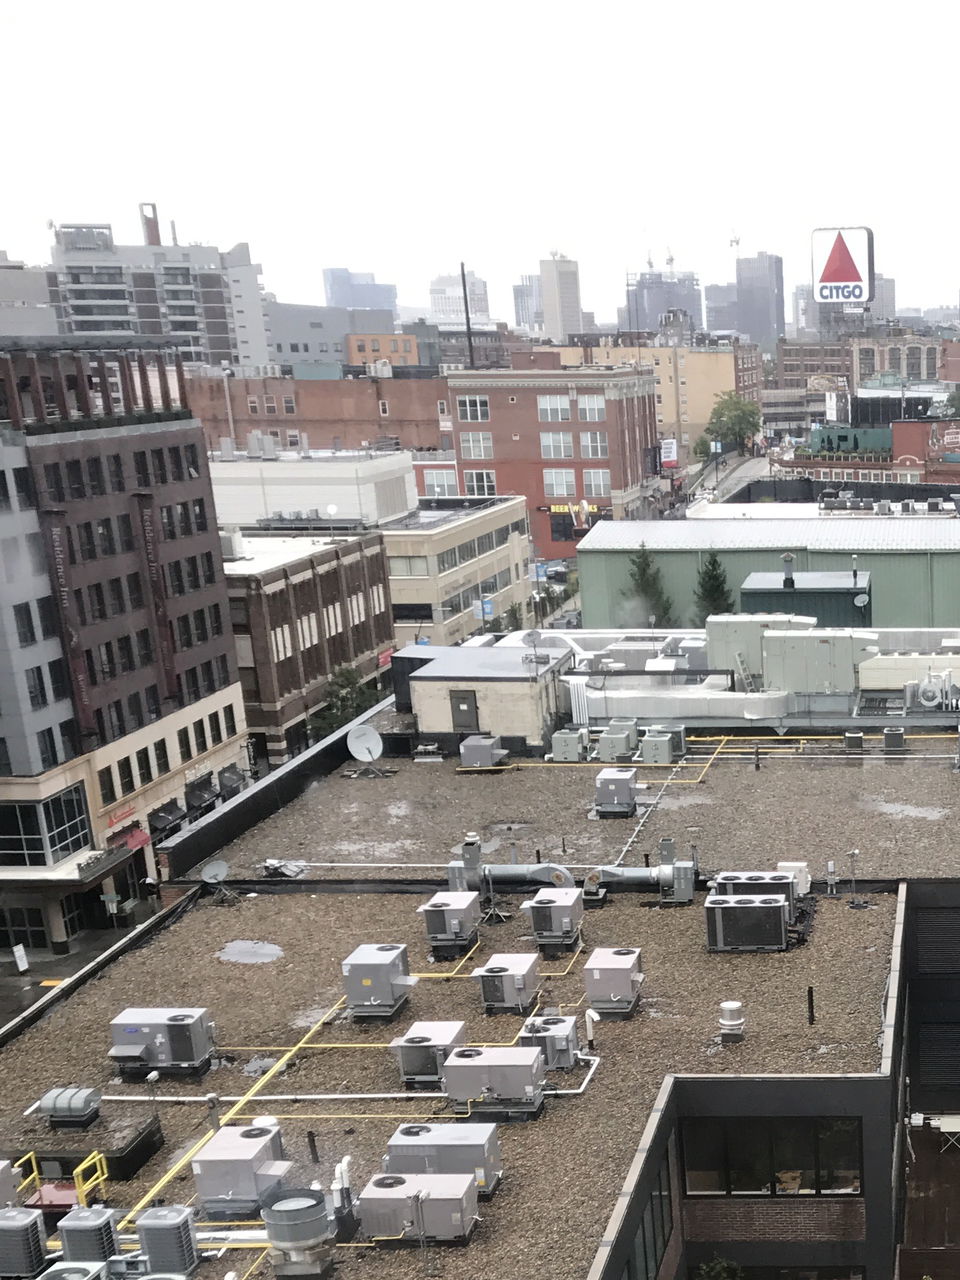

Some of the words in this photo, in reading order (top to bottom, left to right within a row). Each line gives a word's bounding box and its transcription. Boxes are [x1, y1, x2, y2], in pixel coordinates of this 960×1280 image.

[820, 285, 863, 299] CITGO
[51, 527, 65, 586] Residence
[60, 588, 69, 608] Inn
